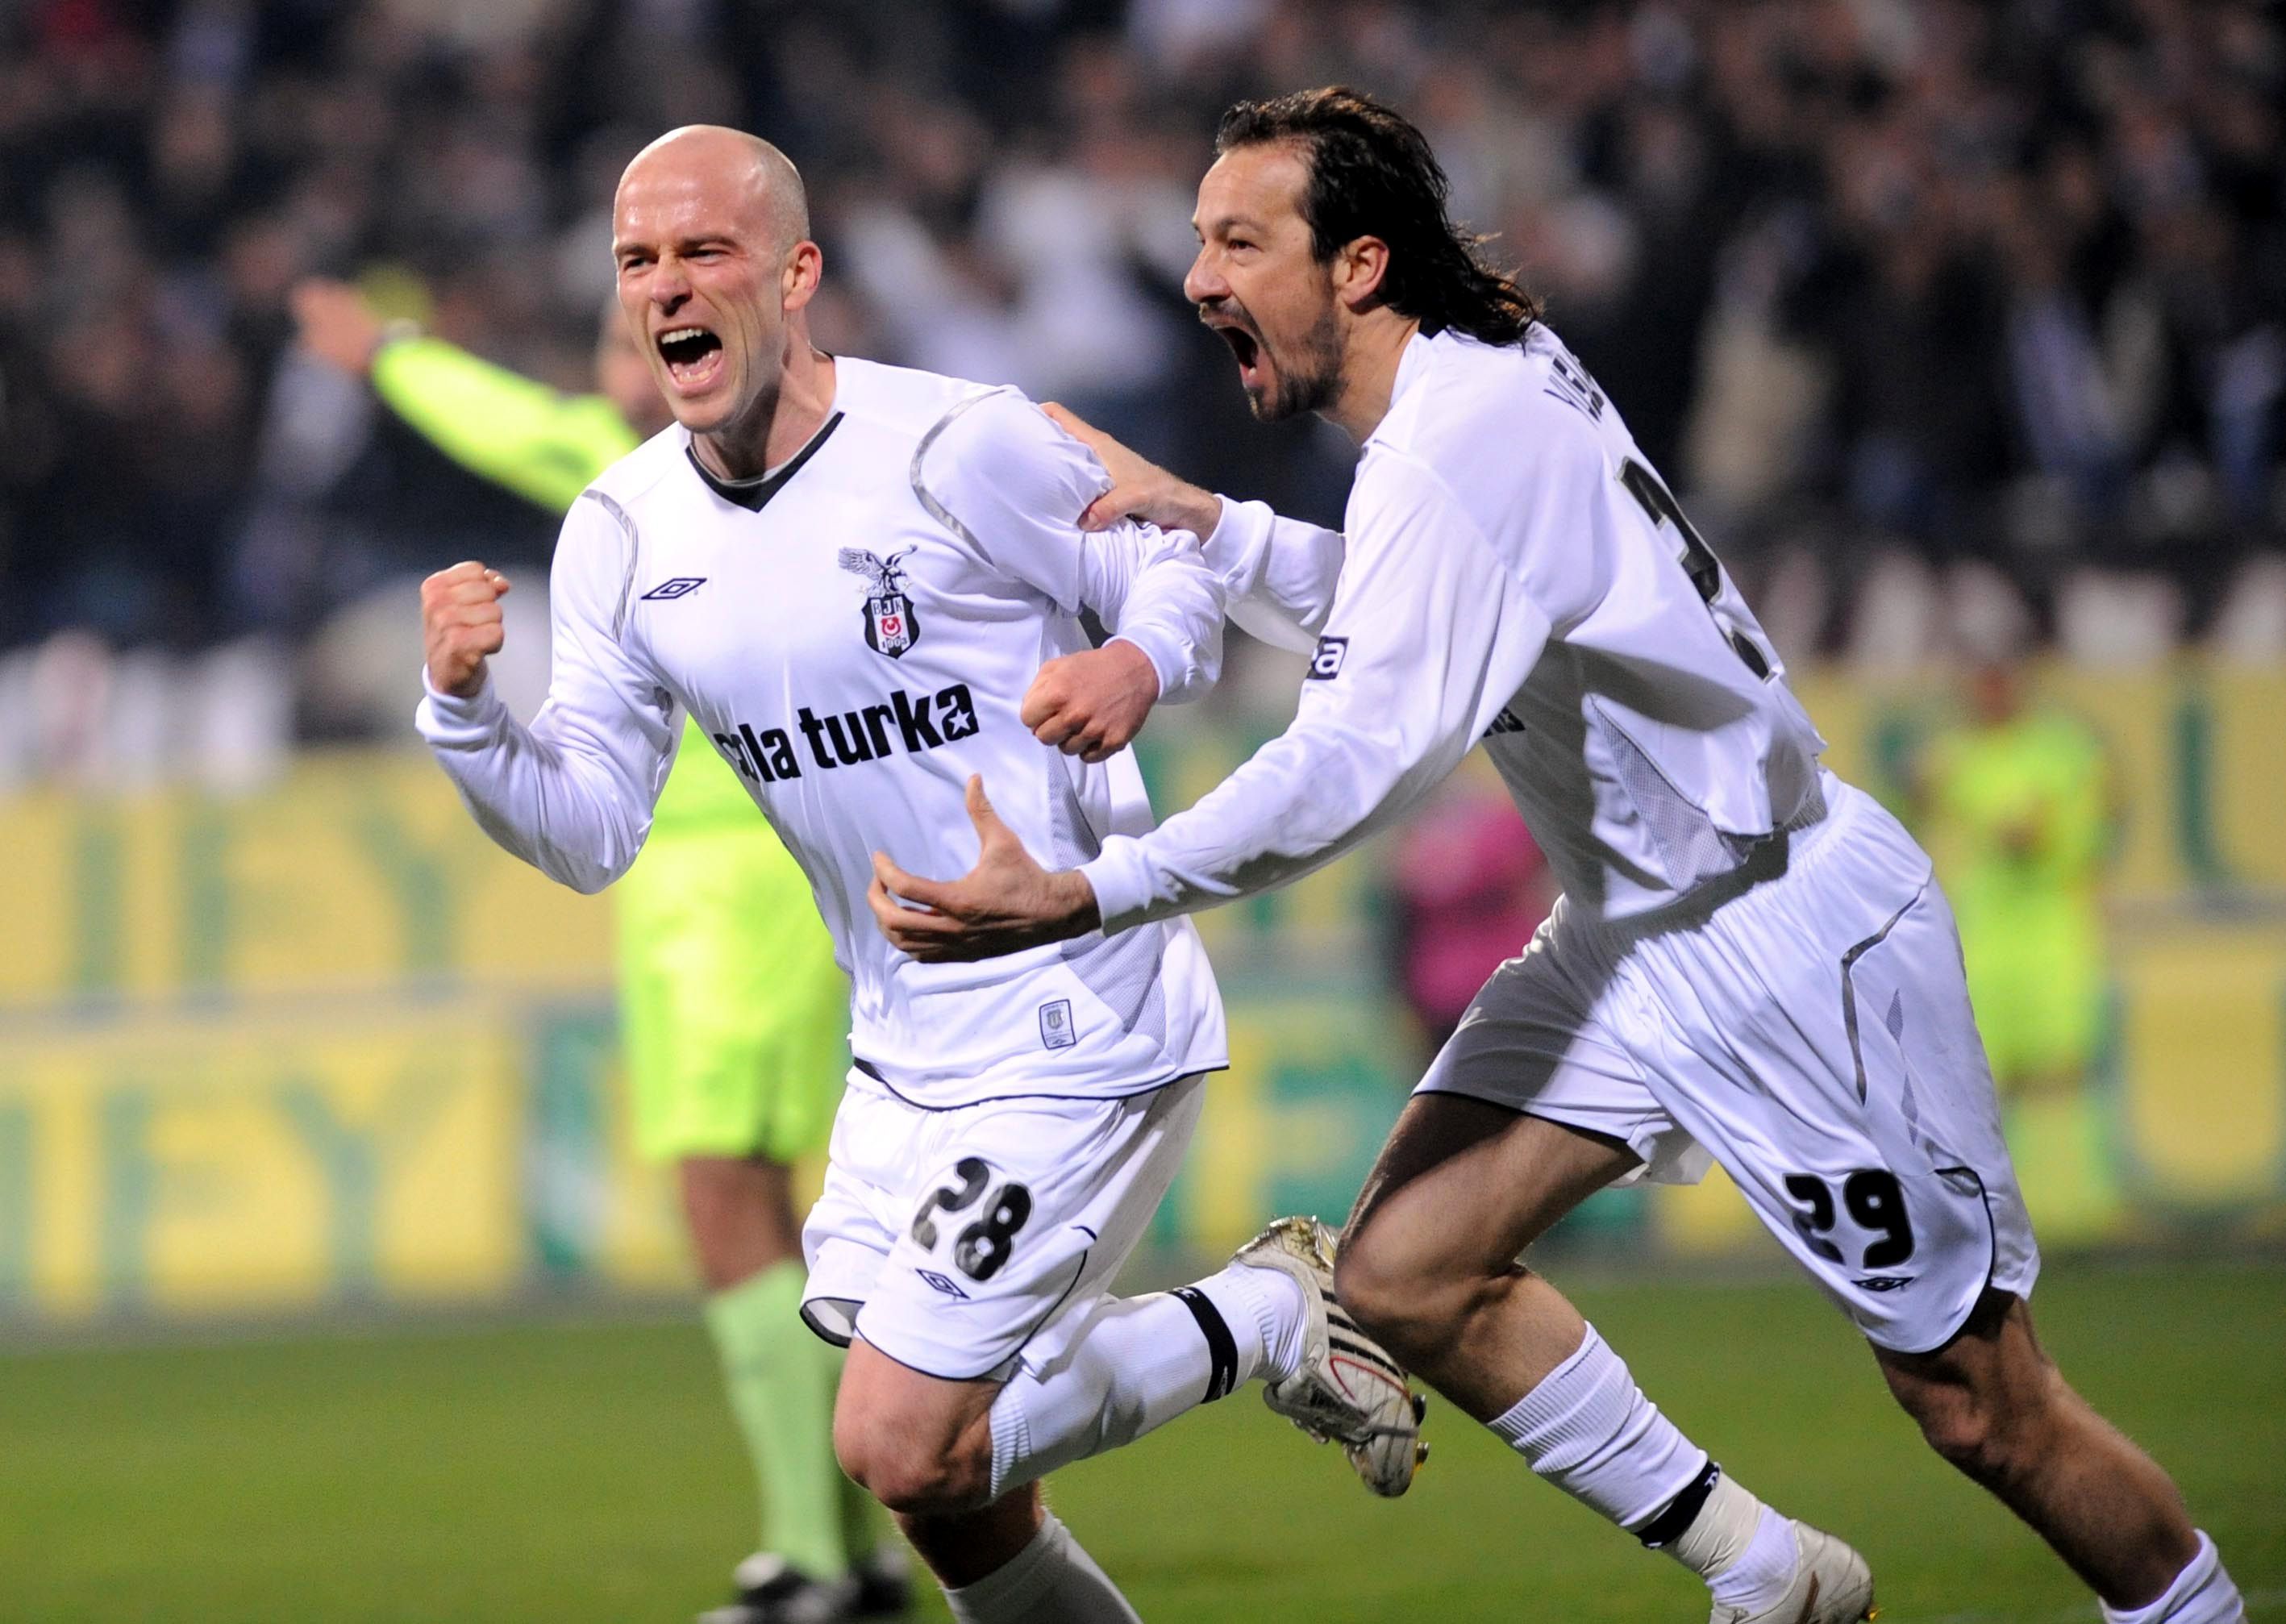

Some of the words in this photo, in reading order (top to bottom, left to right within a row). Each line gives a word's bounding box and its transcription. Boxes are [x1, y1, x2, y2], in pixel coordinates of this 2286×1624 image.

[873, 599, 904, 617] BJK
[881, 636, 910, 650] 1903
[1311, 642, 1345, 674] a
[797, 683, 980, 771] turka
[910, 1156, 1033, 1283] 28
[1782, 1168, 1915, 1269] 29
